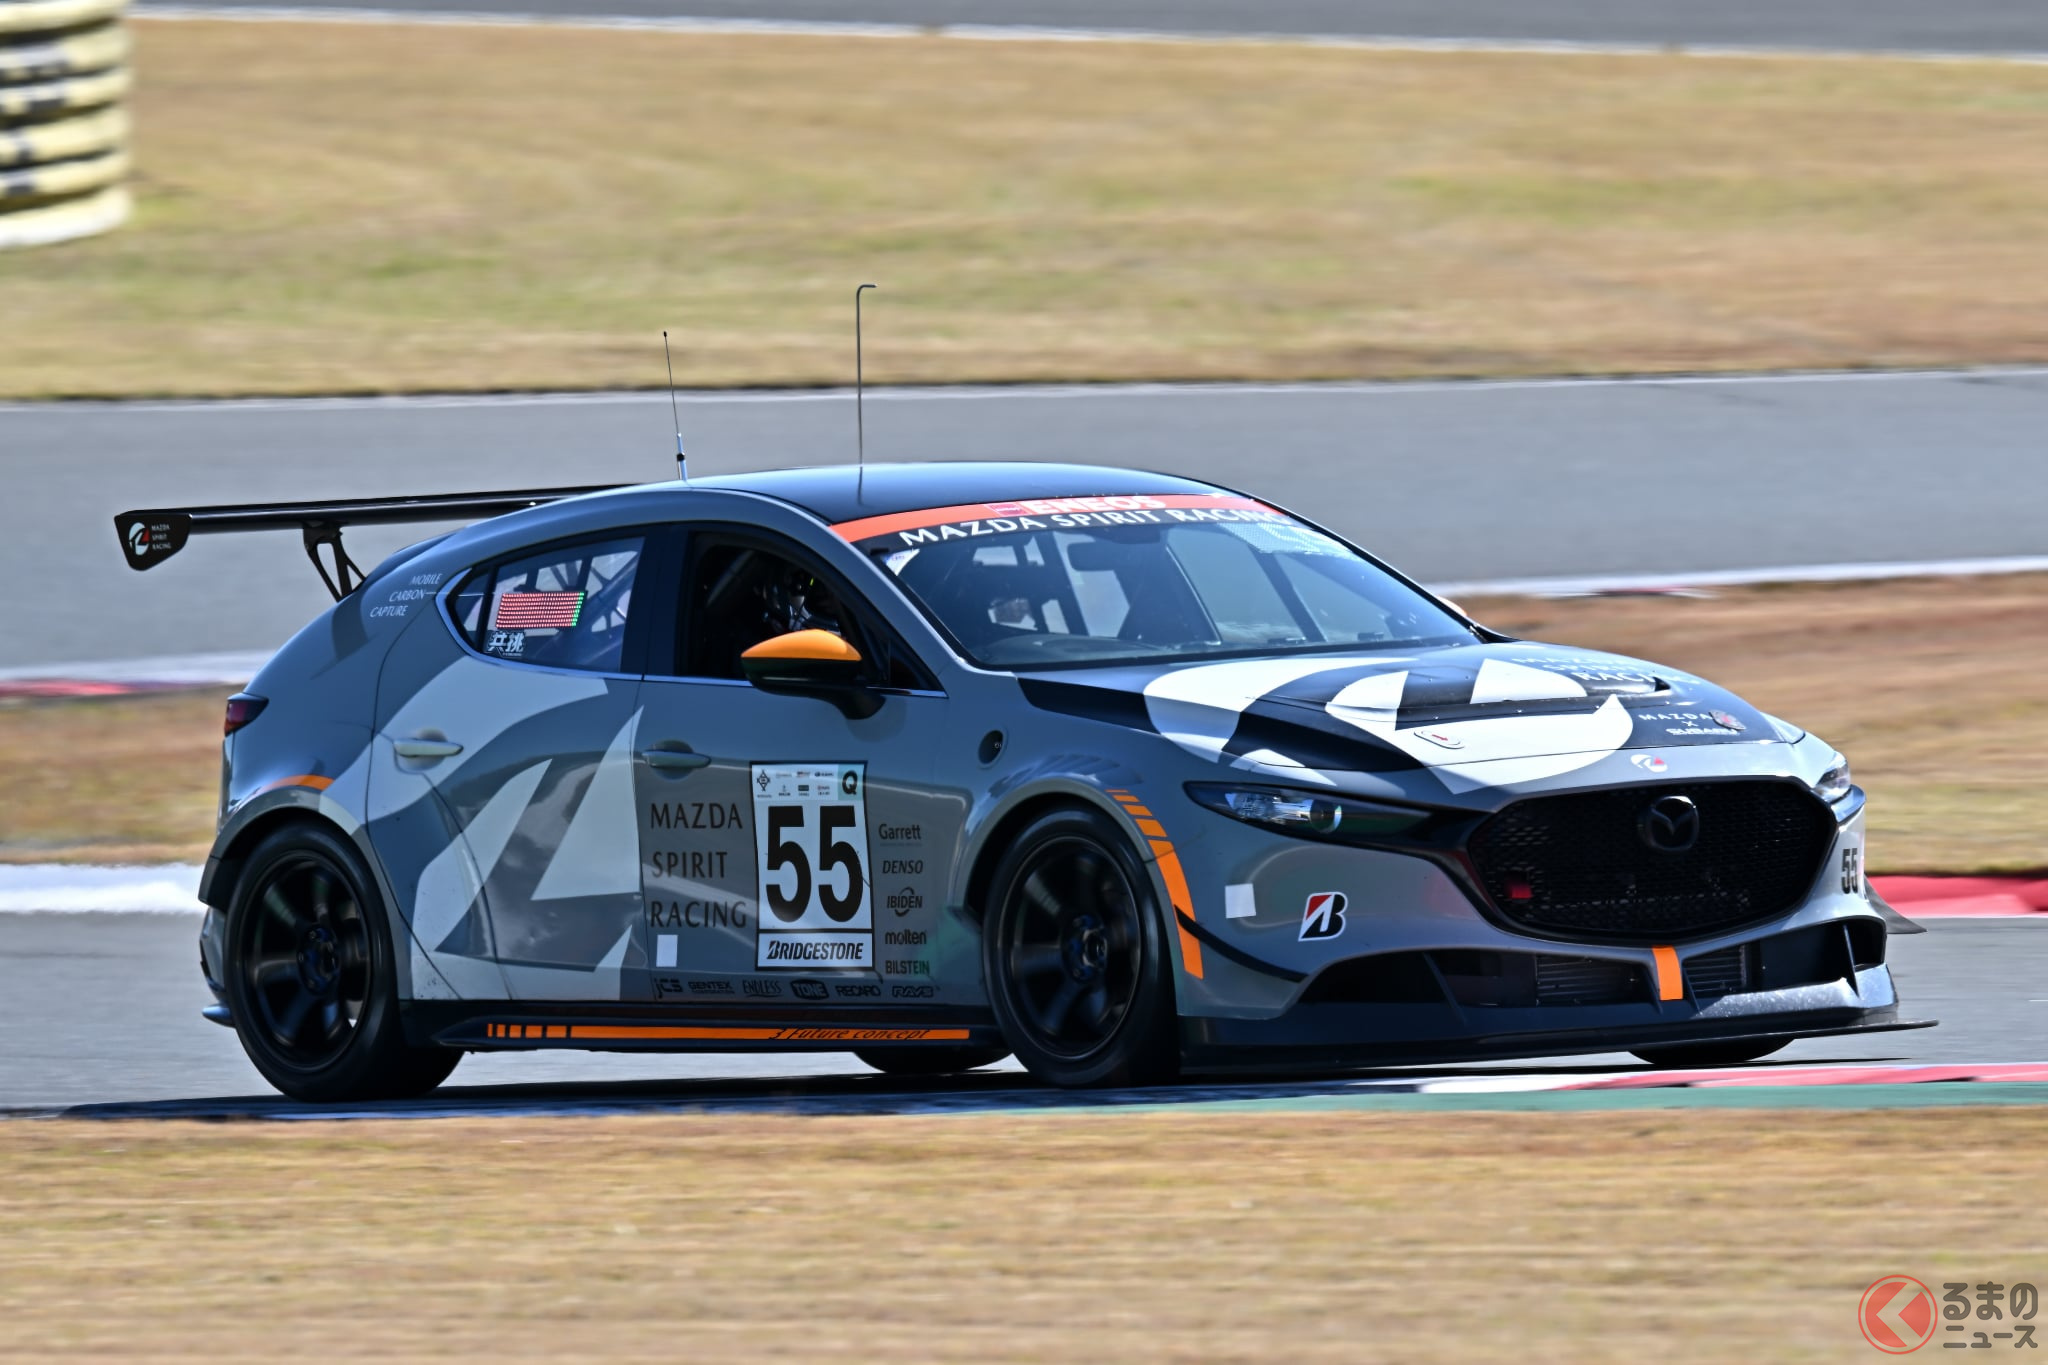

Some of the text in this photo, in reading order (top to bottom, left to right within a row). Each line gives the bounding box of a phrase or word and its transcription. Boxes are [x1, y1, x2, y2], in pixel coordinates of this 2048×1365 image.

[1023, 496, 1166, 514] ENEOS
[900, 509, 1291, 546] MAZDA SPIRIT RACING
[409, 573, 442, 585] MOBILE
[388, 589, 426, 602] CARBON
[369, 605, 408, 617] CAPTURE
[1637, 713, 1713, 721] MAZDA
[841, 770, 858, 795] Q
[651, 803, 743, 829] MAZDA
[878, 823, 922, 840] Garrett
[652, 851, 728, 879] SPIRIT
[765, 805, 863, 923] 55
[882, 860, 924, 874] DENSO
[1841, 848, 1858, 894] 55
[886, 895, 923, 909] IBIDEN
[650, 900, 747, 928] RACING
[884, 930, 927, 945] molten
[766, 940, 864, 960] BRIDGESTONE
[885, 960, 931, 975] BILSTEIN
[743, 980, 782, 994] ENDLESS
[792, 982, 825, 996] TONE
[835, 984, 882, 997] RECARO
[891, 985, 934, 997] RAYS
[787, 1028, 850, 1040] Future
[852, 1028, 931, 1040] concept
